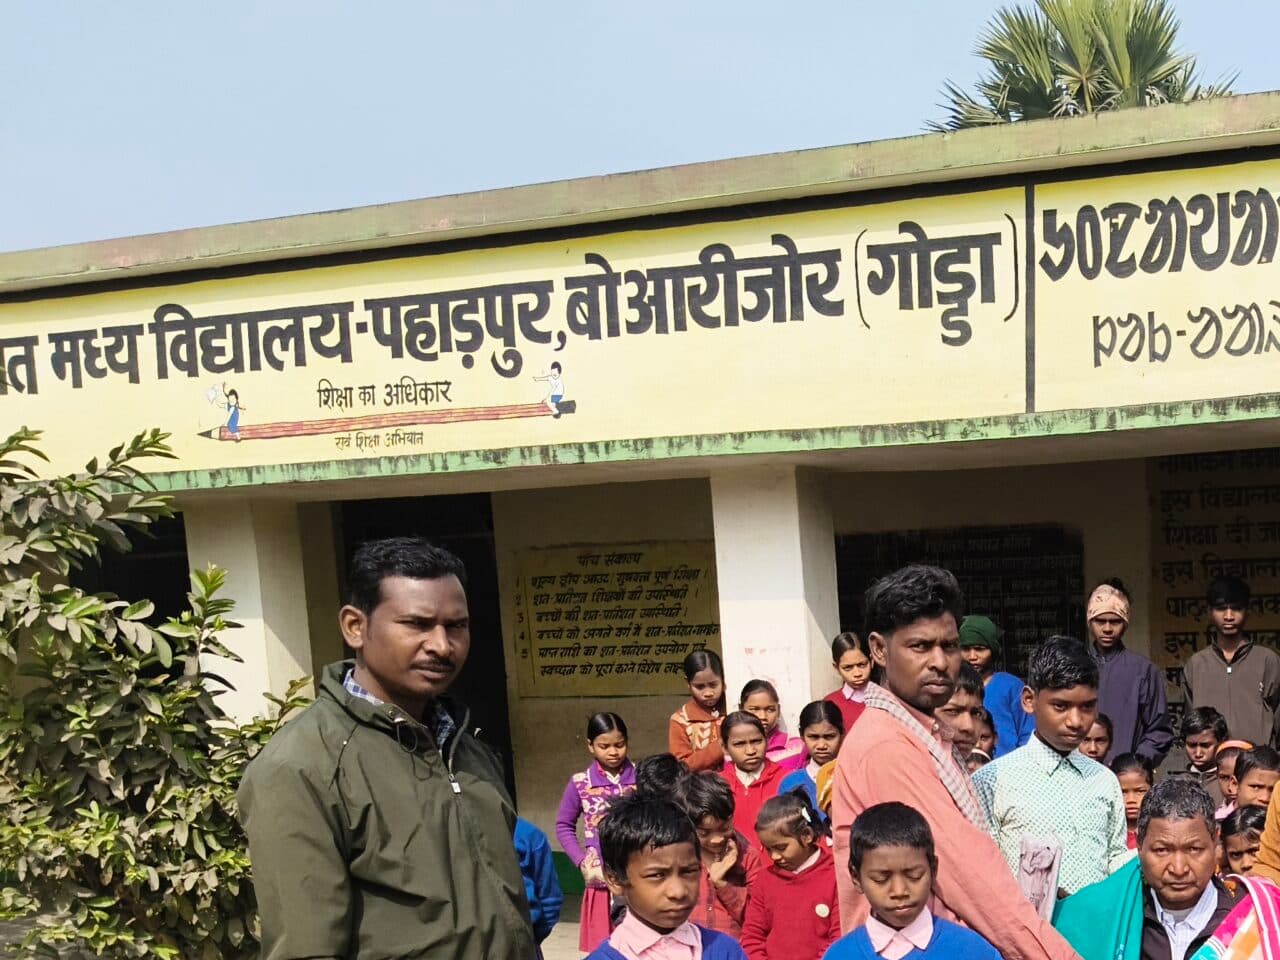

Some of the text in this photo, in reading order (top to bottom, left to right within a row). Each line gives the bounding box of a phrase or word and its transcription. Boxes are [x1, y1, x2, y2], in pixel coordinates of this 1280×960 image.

[47, 323, 144, 389] मध्य
[316, 376, 453, 413] शिक्षा का अधिकार
[356, 431, 380, 453] शिक्षा
[385, 428, 424, 448] अभियान
